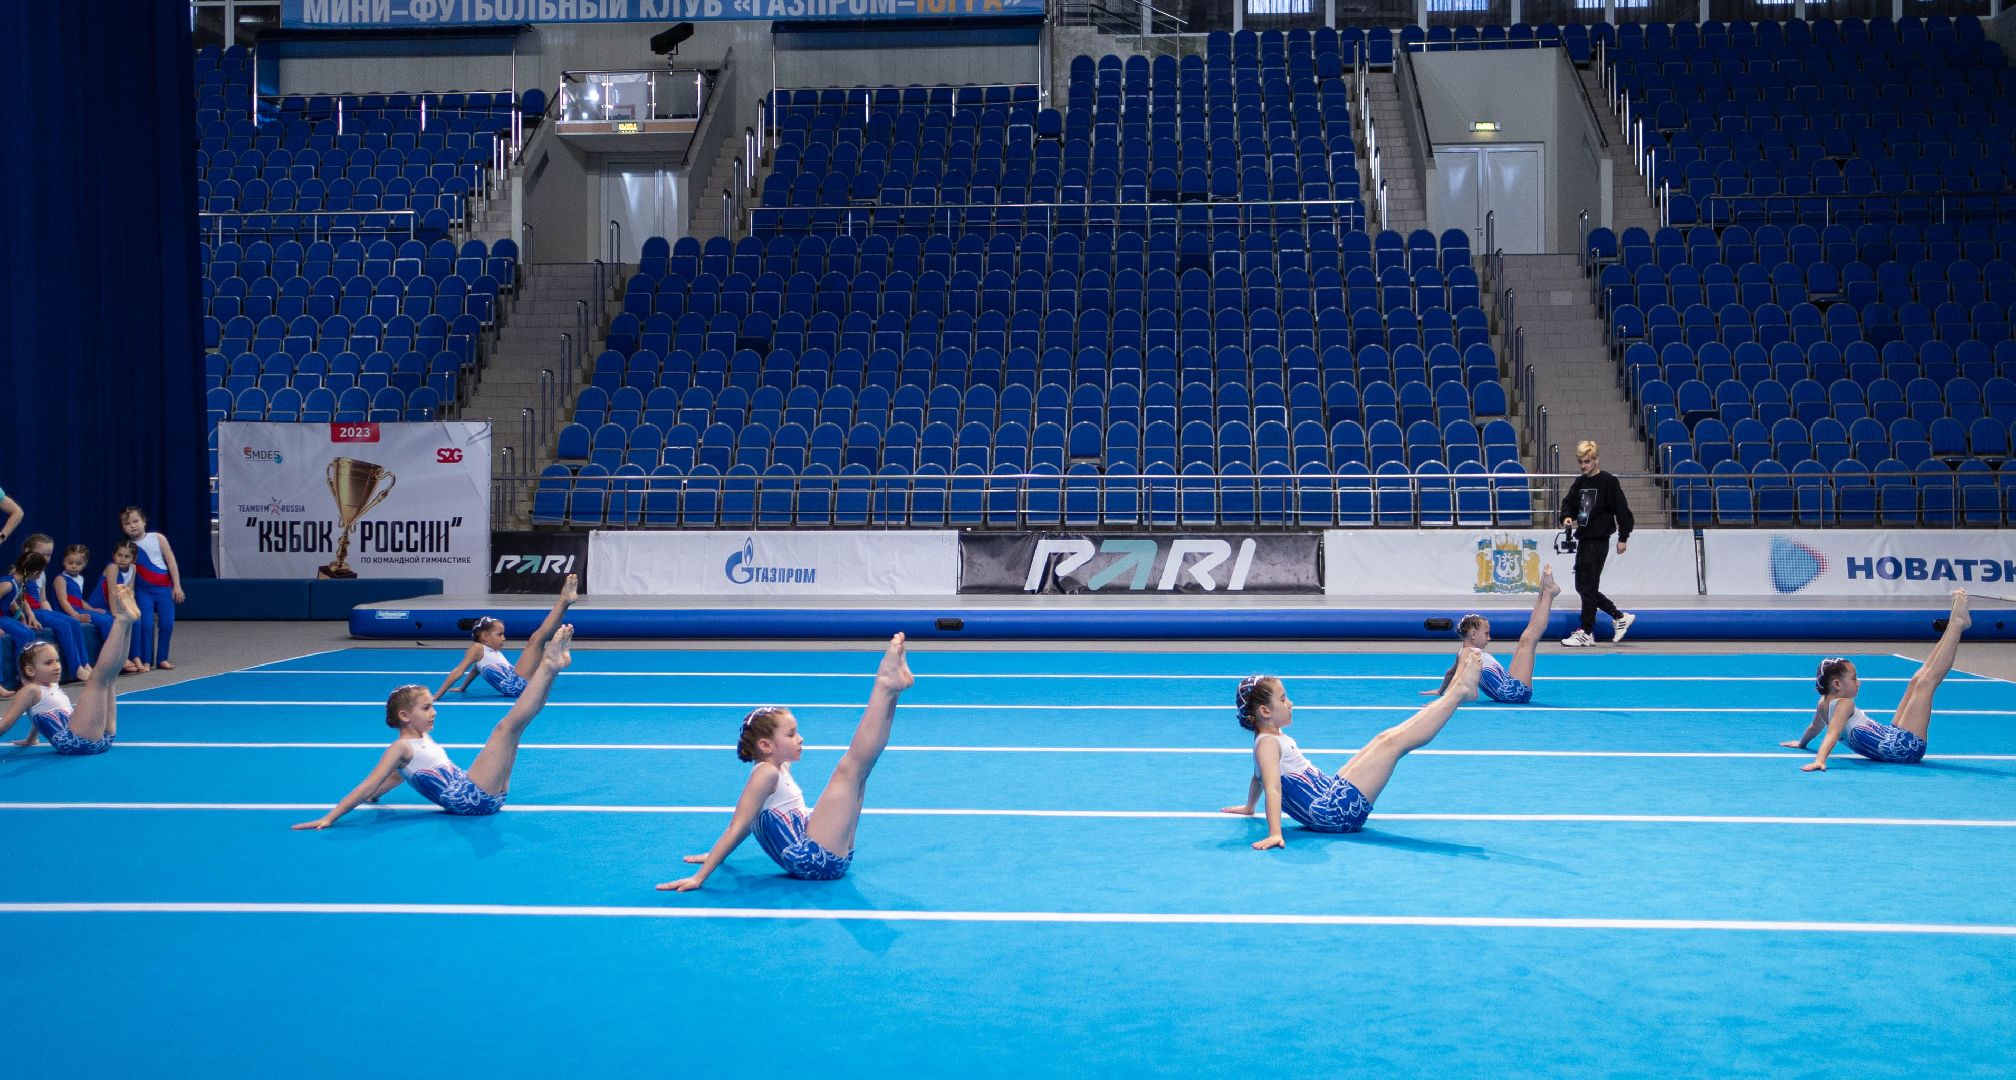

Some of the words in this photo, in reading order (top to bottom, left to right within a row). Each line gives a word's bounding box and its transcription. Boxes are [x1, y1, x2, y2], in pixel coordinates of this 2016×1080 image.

[339, 427, 371, 438] 2023
[245, 450, 280, 460] SMDES
[238, 504, 269, 513] TEAMGYM
[281, 504, 306, 513] RUSSIA
[360, 556, 371, 564] ПО
[373, 555, 420, 565] КОМАНДНОЙ
[421, 556, 472, 564] ГИМНАСТИКЕ
[494, 554, 576, 574] PARI
[1023, 537, 1257, 591] PARI
[754, 566, 816, 584] ГАЗПРОМ
